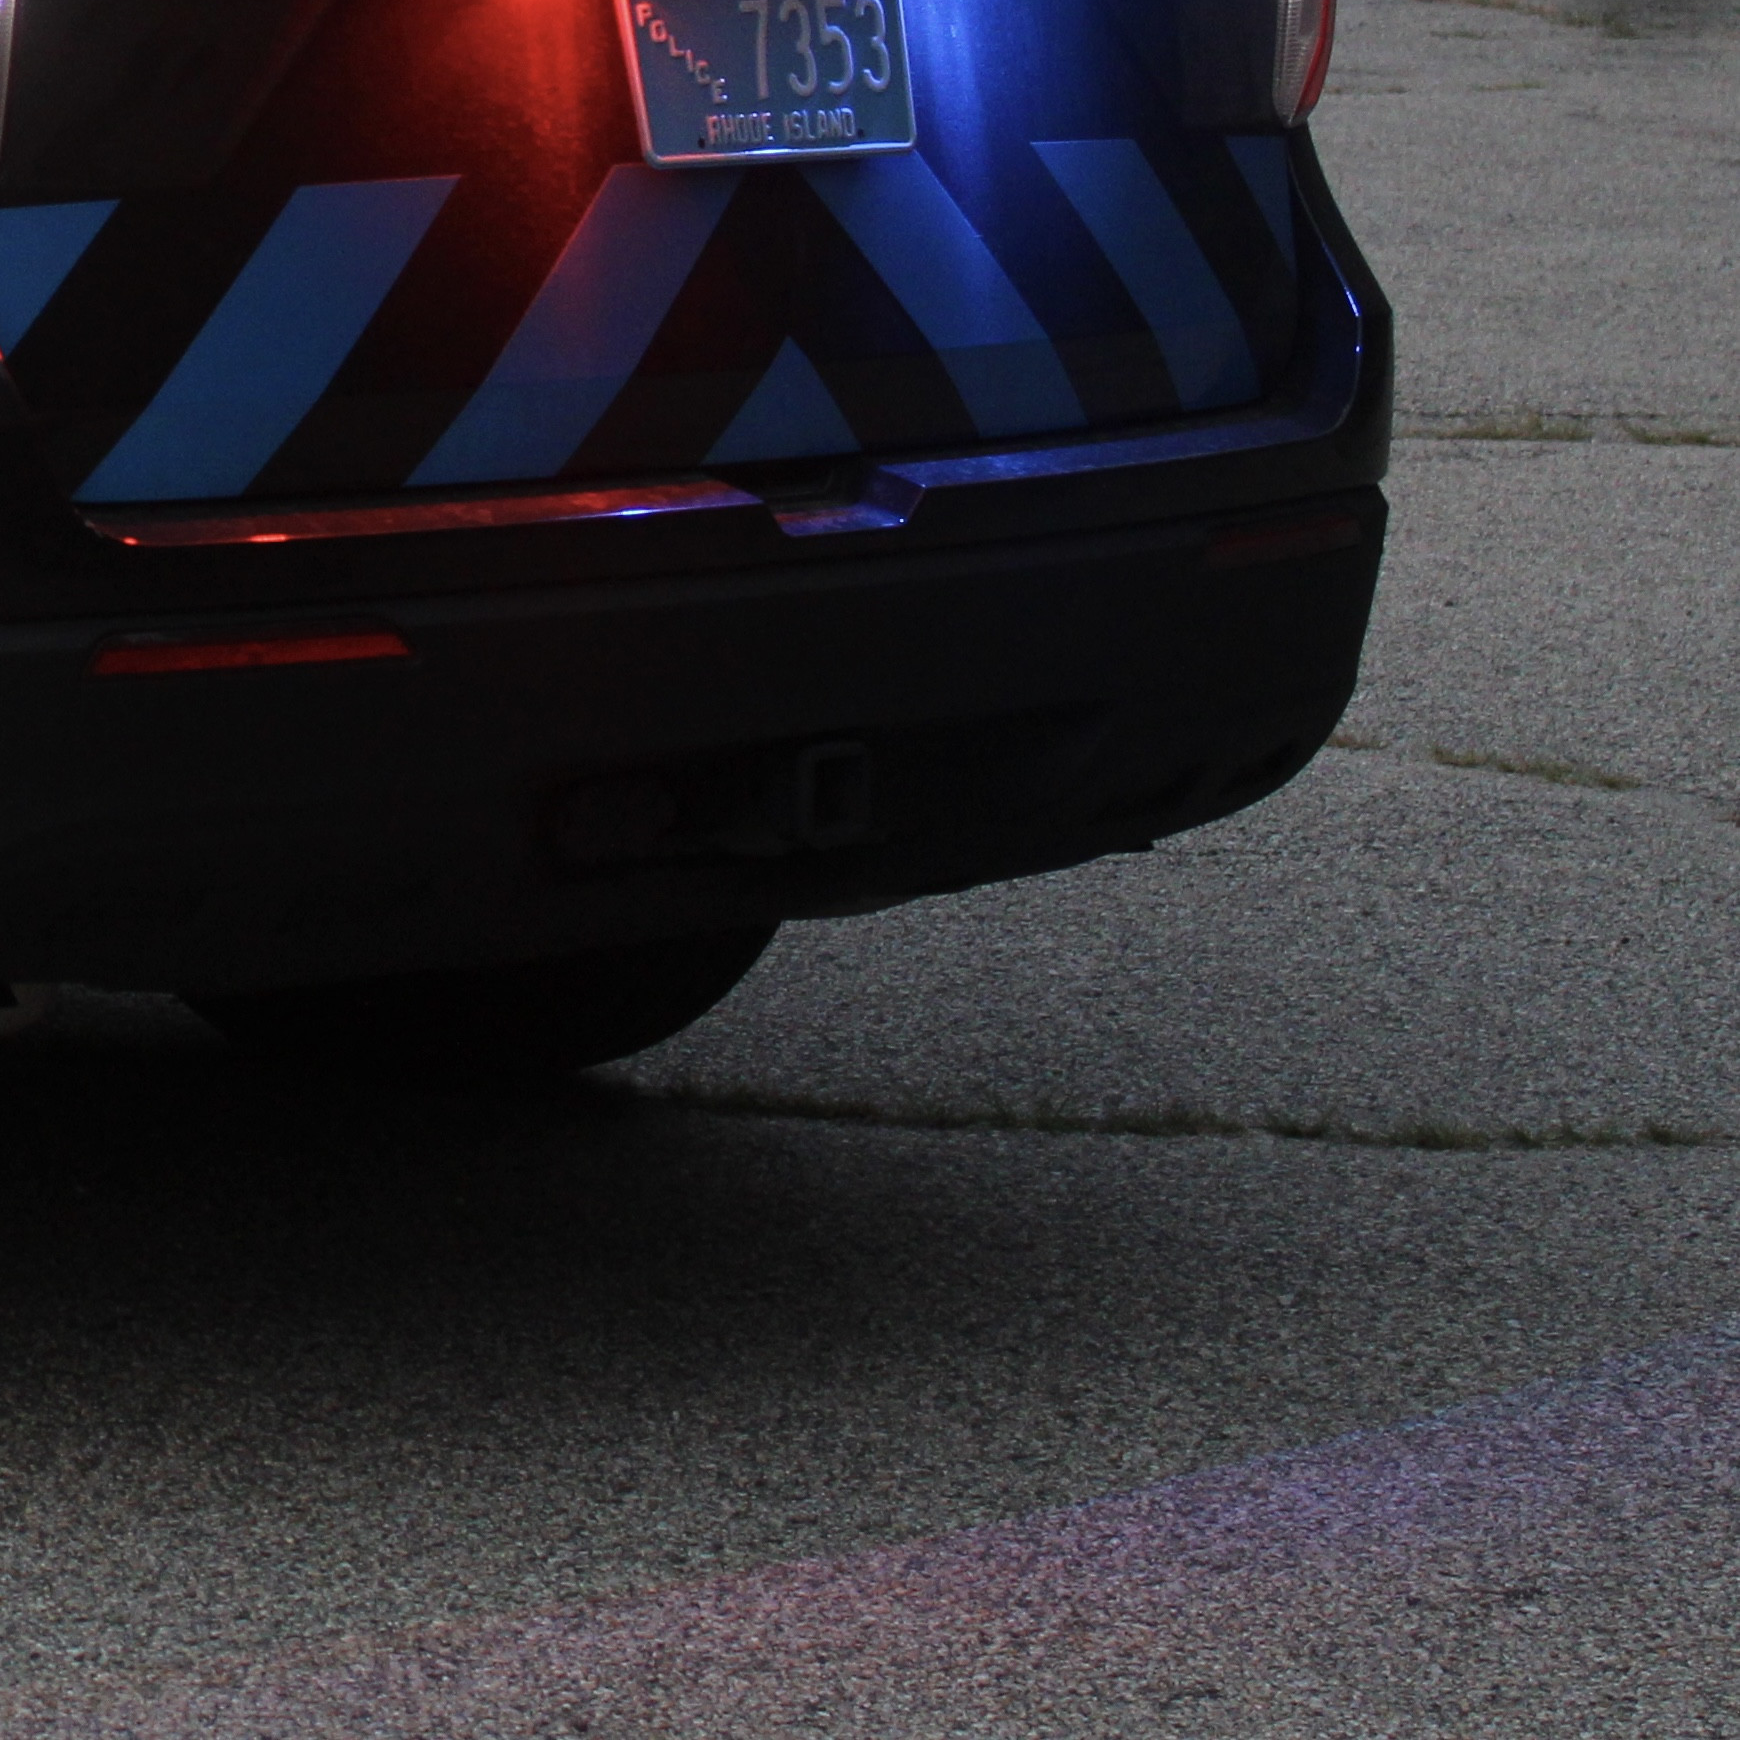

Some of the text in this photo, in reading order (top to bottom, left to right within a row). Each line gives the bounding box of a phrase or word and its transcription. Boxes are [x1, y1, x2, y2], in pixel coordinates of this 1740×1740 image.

[635, 1, 729, 104] POLICE
[706, 107, 857, 146] RHODE ISLAND
